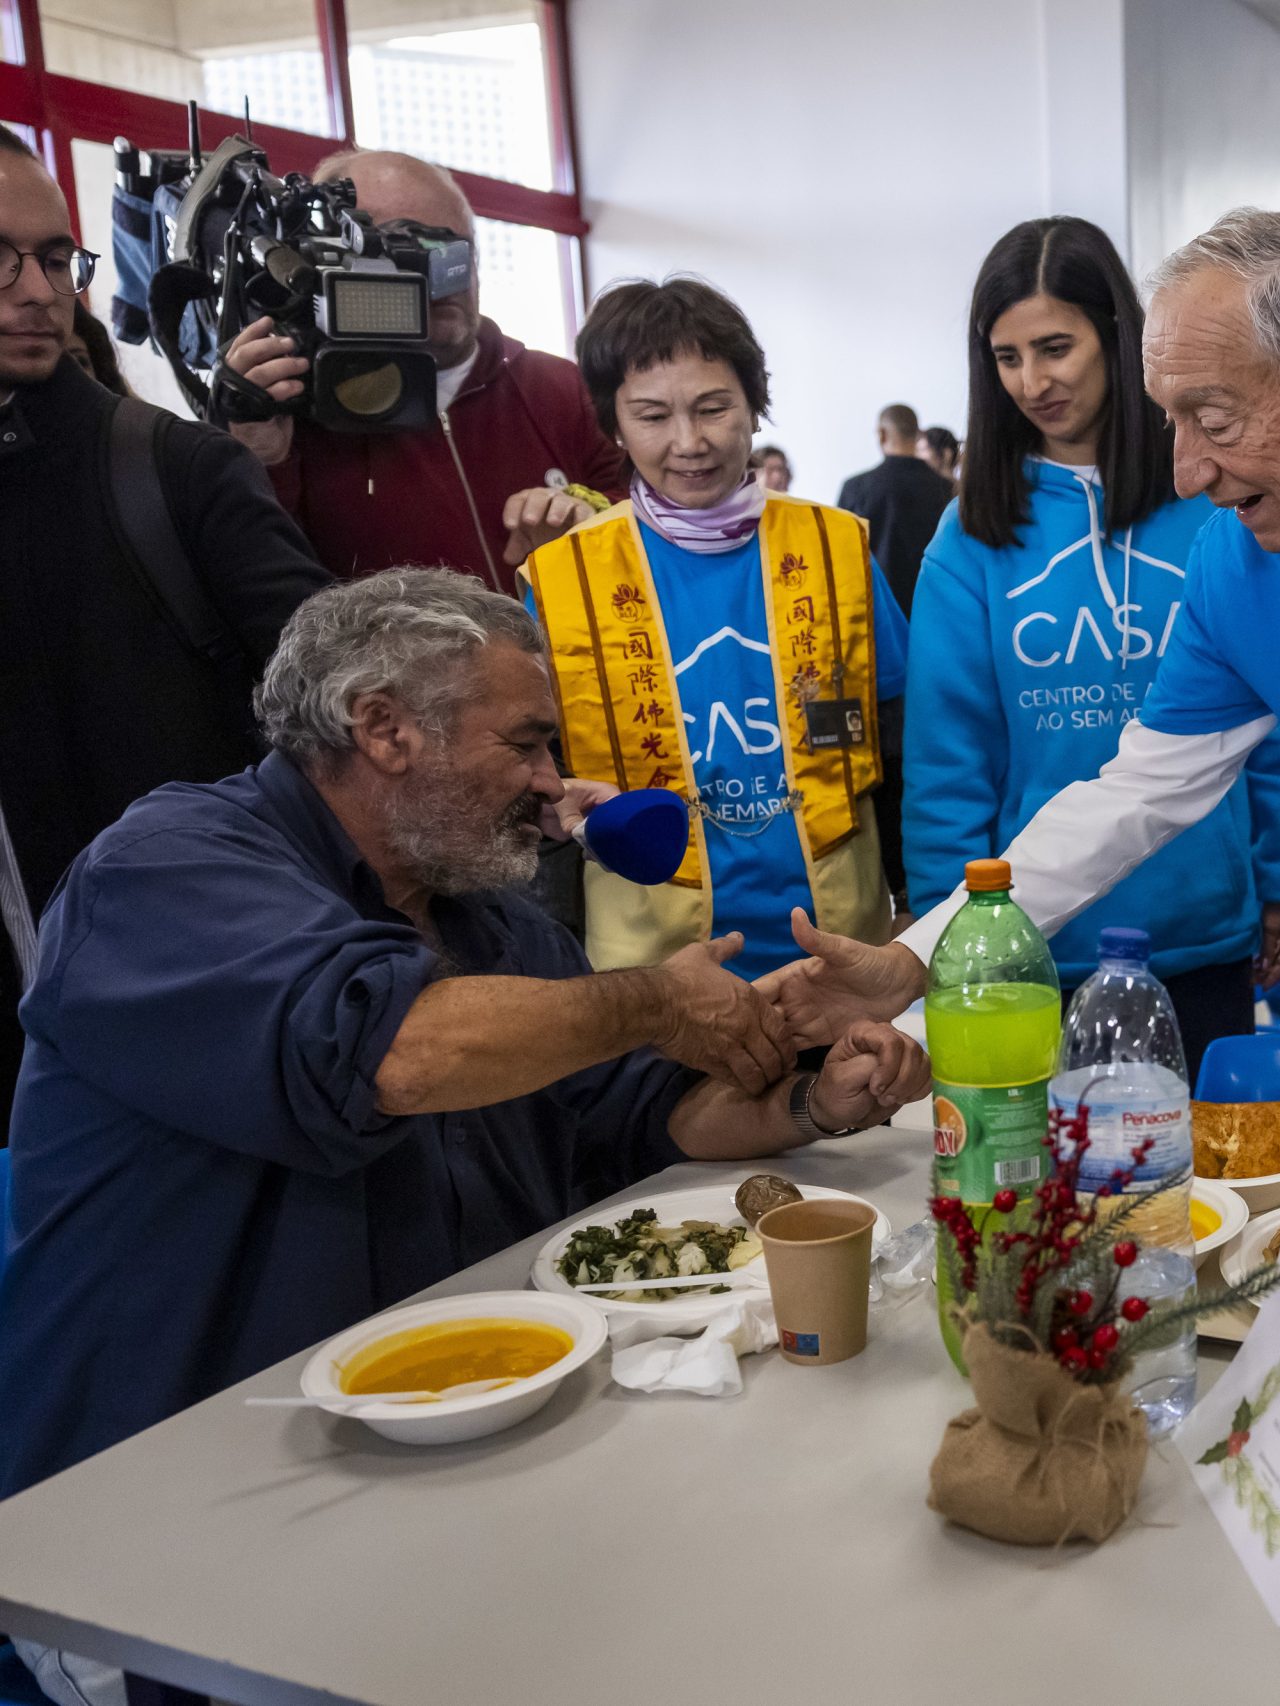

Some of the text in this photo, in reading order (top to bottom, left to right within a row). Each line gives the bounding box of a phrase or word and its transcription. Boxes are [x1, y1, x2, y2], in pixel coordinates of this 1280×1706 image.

[1018, 684, 1105, 708] CENTRO
[1036, 711, 1064, 731] AO
[1071, 709, 1114, 729] SEM
[1122, 1110, 1182, 1126] Penacova
